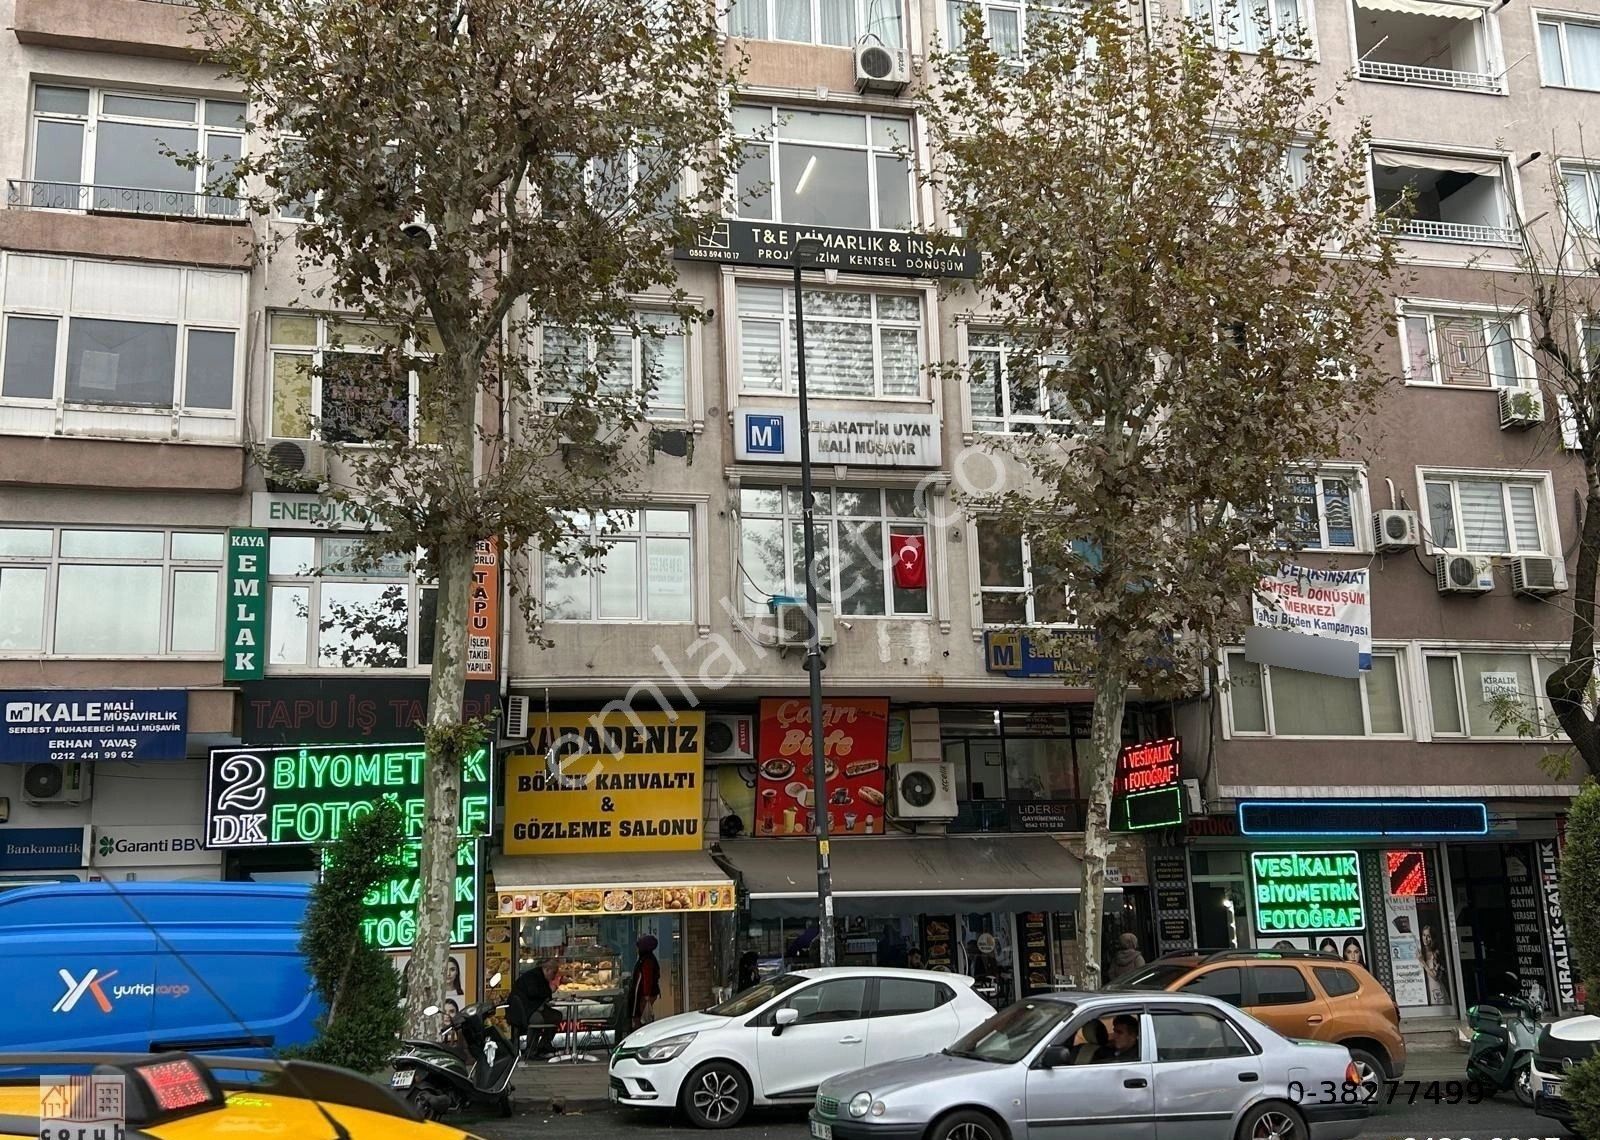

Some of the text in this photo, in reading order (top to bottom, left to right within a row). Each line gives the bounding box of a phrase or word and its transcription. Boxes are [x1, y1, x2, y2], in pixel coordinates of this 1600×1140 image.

[752, 229, 788, 244] T&E
[889, 238, 901, 252] &
[849, 255, 897, 268] KENTSEL
[906, 259, 964, 273] DÖNÜŞÜM
[808, 420, 931, 437] ELAHATTİN UYAN
[818, 438, 916, 457] MALİ MÜŞAVİR
[232, 535, 265, 548] KAYA
[473, 572, 488, 629] TAPU
[1307, 588, 1366, 606] DÖNÜŞÜM
[233, 555, 259, 671] EMLAK
[1284, 600, 1336, 618] MERKEZİ
[1281, 612, 1311, 629] Bizden
[1313, 618, 1369, 637] Kampanyası
[467, 662, 492, 673] YAPILIR
[34, 702, 102, 722] KALE
[103, 700, 134, 711] MALİ
[103, 711, 177, 723] MÜŞAVİRLİK
[251, 701, 338, 729] TAPU
[389, 692, 491, 729] TABİ
[8, 723, 181, 734] SERBEST MUHASEBECİ MALİ MÜŞAVİR
[48, 738, 137, 750] ERHAN YAVAŞ
[51, 752, 76, 760] 0212
[104, 751, 117, 759] 99
[121, 751, 134, 759] 62
[1129, 743, 1173, 769] VESİKALIK
[273, 749, 487, 790] BİYOMETK
[1129, 765, 1175, 789] FOTOĞRAF
[218, 754, 266, 811] 2
[595, 773, 695, 791] KAHVALTI
[601, 796, 615, 812] &
[271, 792, 487, 842] FOTORF
[212, 813, 268, 844] DK
[514, 818, 698, 840] GÖZLEME SALONU
[7, 843, 81, 854] Bankamatik
[115, 838, 207, 853] Garanti BBV
[1254, 853, 1358, 878] VESİKALIK
[1257, 878, 1360, 904] BİYOMETRİK
[1510, 885, 1533, 896] ALIM
[1511, 899, 1535, 908] SATIM
[1259, 903, 1361, 930] FOTOĞRAF
